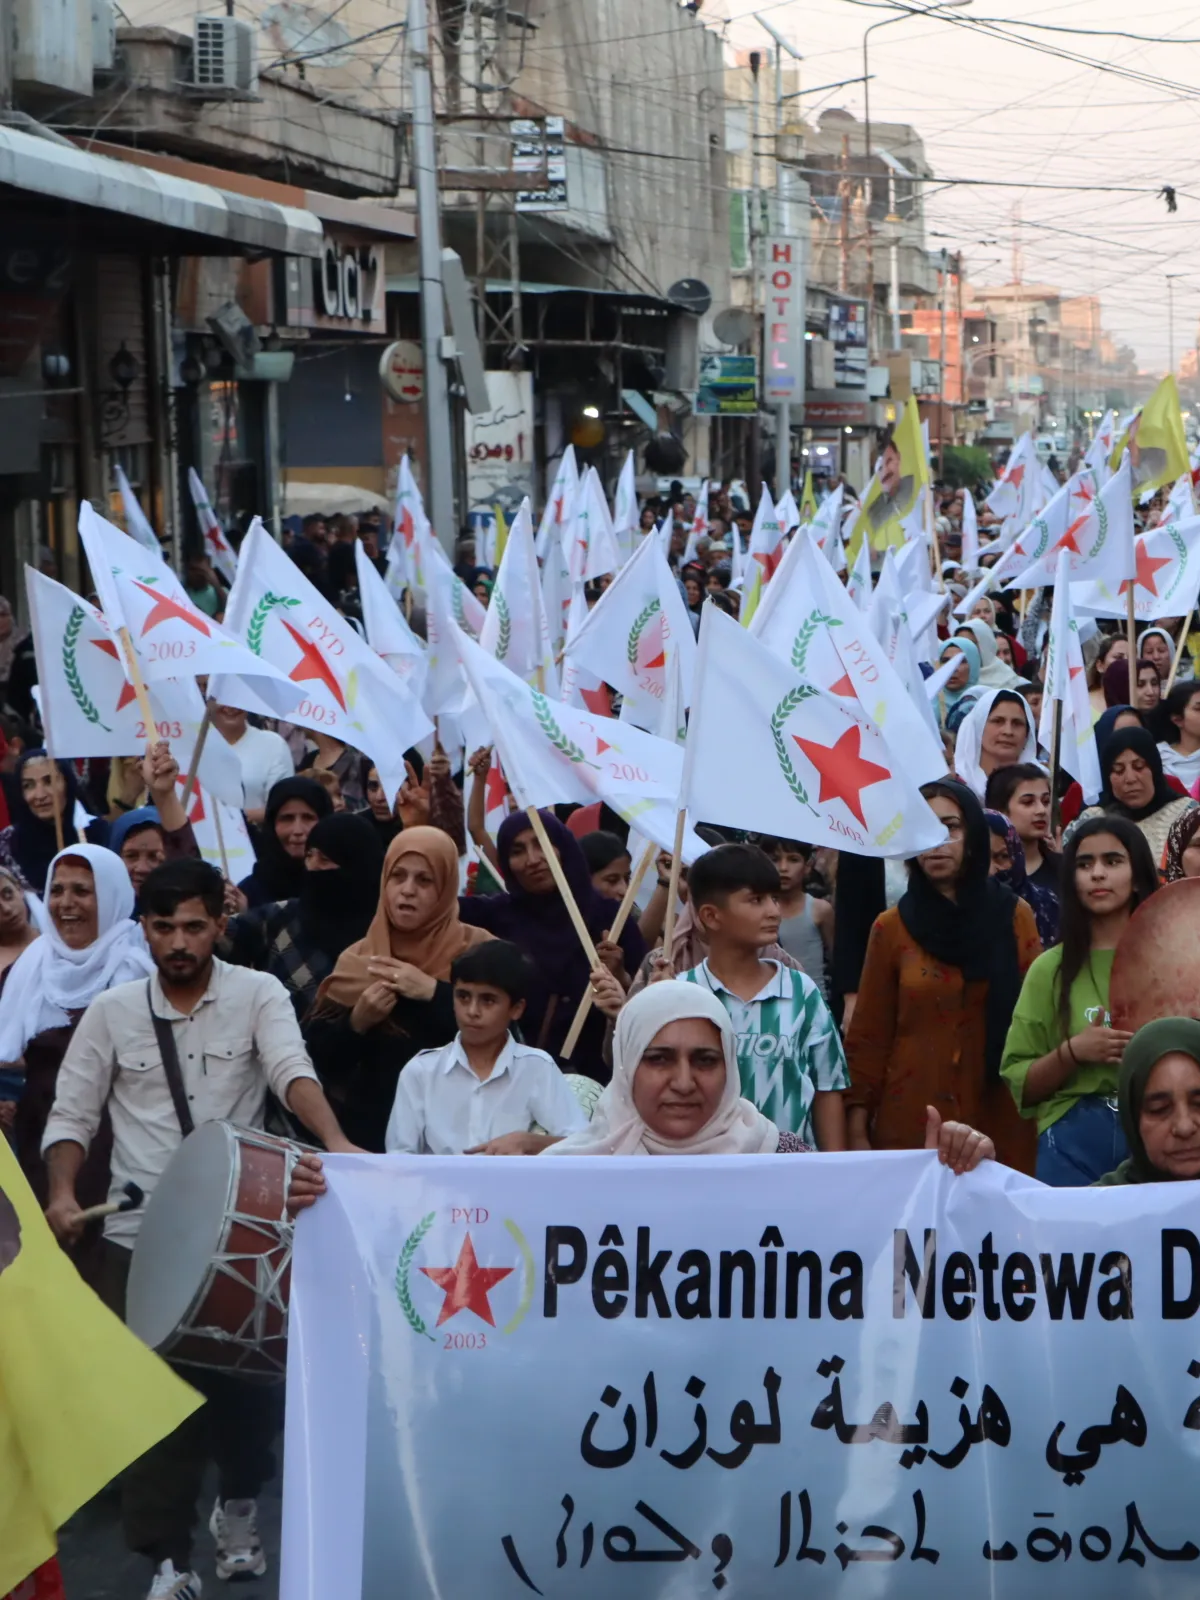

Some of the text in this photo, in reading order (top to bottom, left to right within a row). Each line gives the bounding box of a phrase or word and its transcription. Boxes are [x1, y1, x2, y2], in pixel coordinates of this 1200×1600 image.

[771, 244, 793, 369] HOTEL
[148, 640, 196, 662] 2003
[307, 616, 345, 657] PYD
[844, 639, 879, 683] PYD
[639, 675, 665, 702] 200
[135, 720, 183, 739] 203
[293, 700, 337, 726] 003
[827, 814, 866, 846] 2003
[451, 1207, 489, 1225] PYD
[542, 1223, 864, 1321] Pêkanîna
[892, 1228, 1135, 1322] Netewa
[443, 1332, 487, 1350] 2003
[580, 1366, 783, 1470] لوزان
[810, 1354, 1012, 1471] هزيمة
[1045, 1383, 1148, 1488] هي
